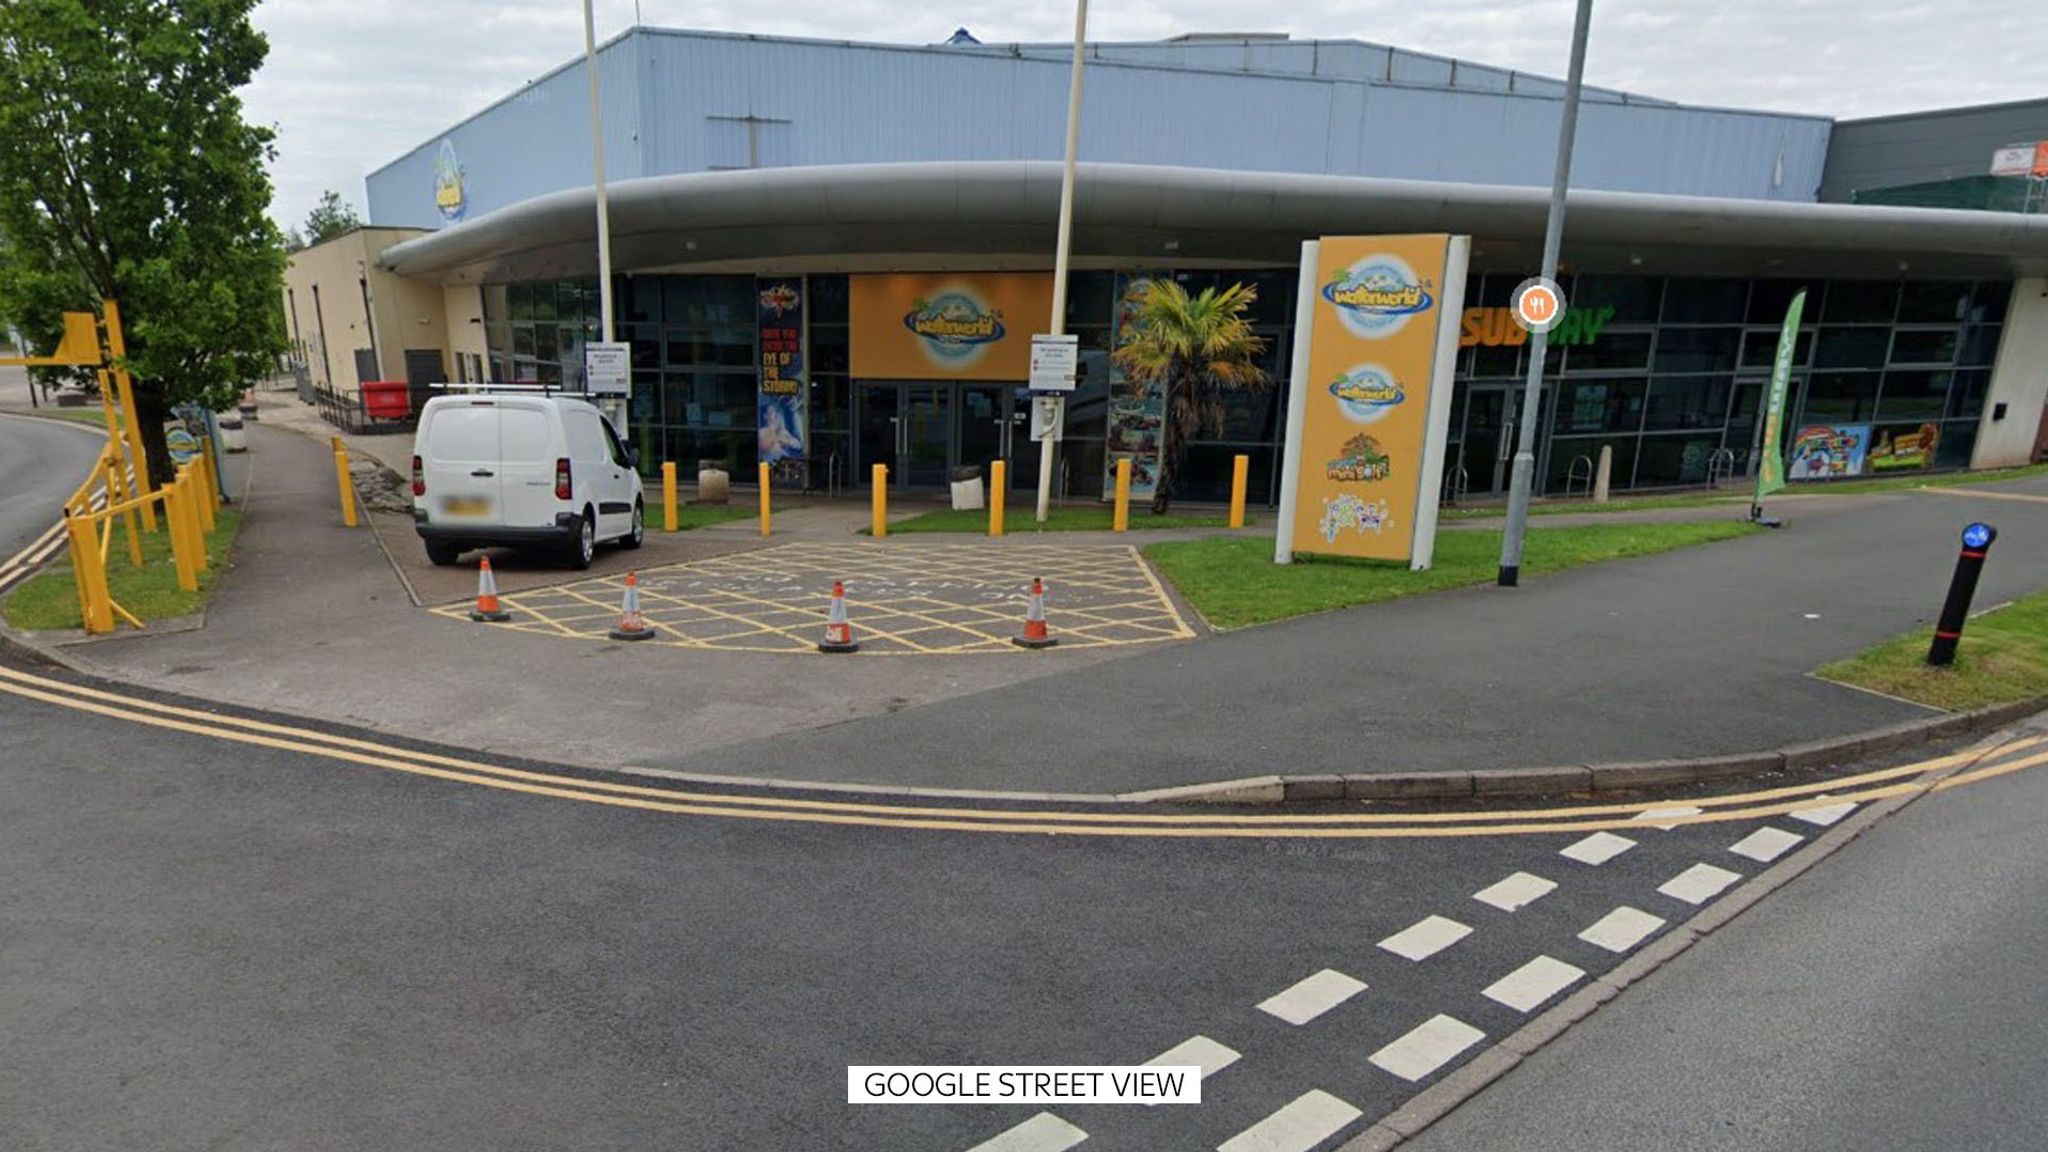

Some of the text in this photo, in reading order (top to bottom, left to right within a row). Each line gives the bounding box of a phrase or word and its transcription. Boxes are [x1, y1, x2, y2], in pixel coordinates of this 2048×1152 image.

[763, 352, 792, 365] EYE OF
[763, 367, 779, 379] THE
